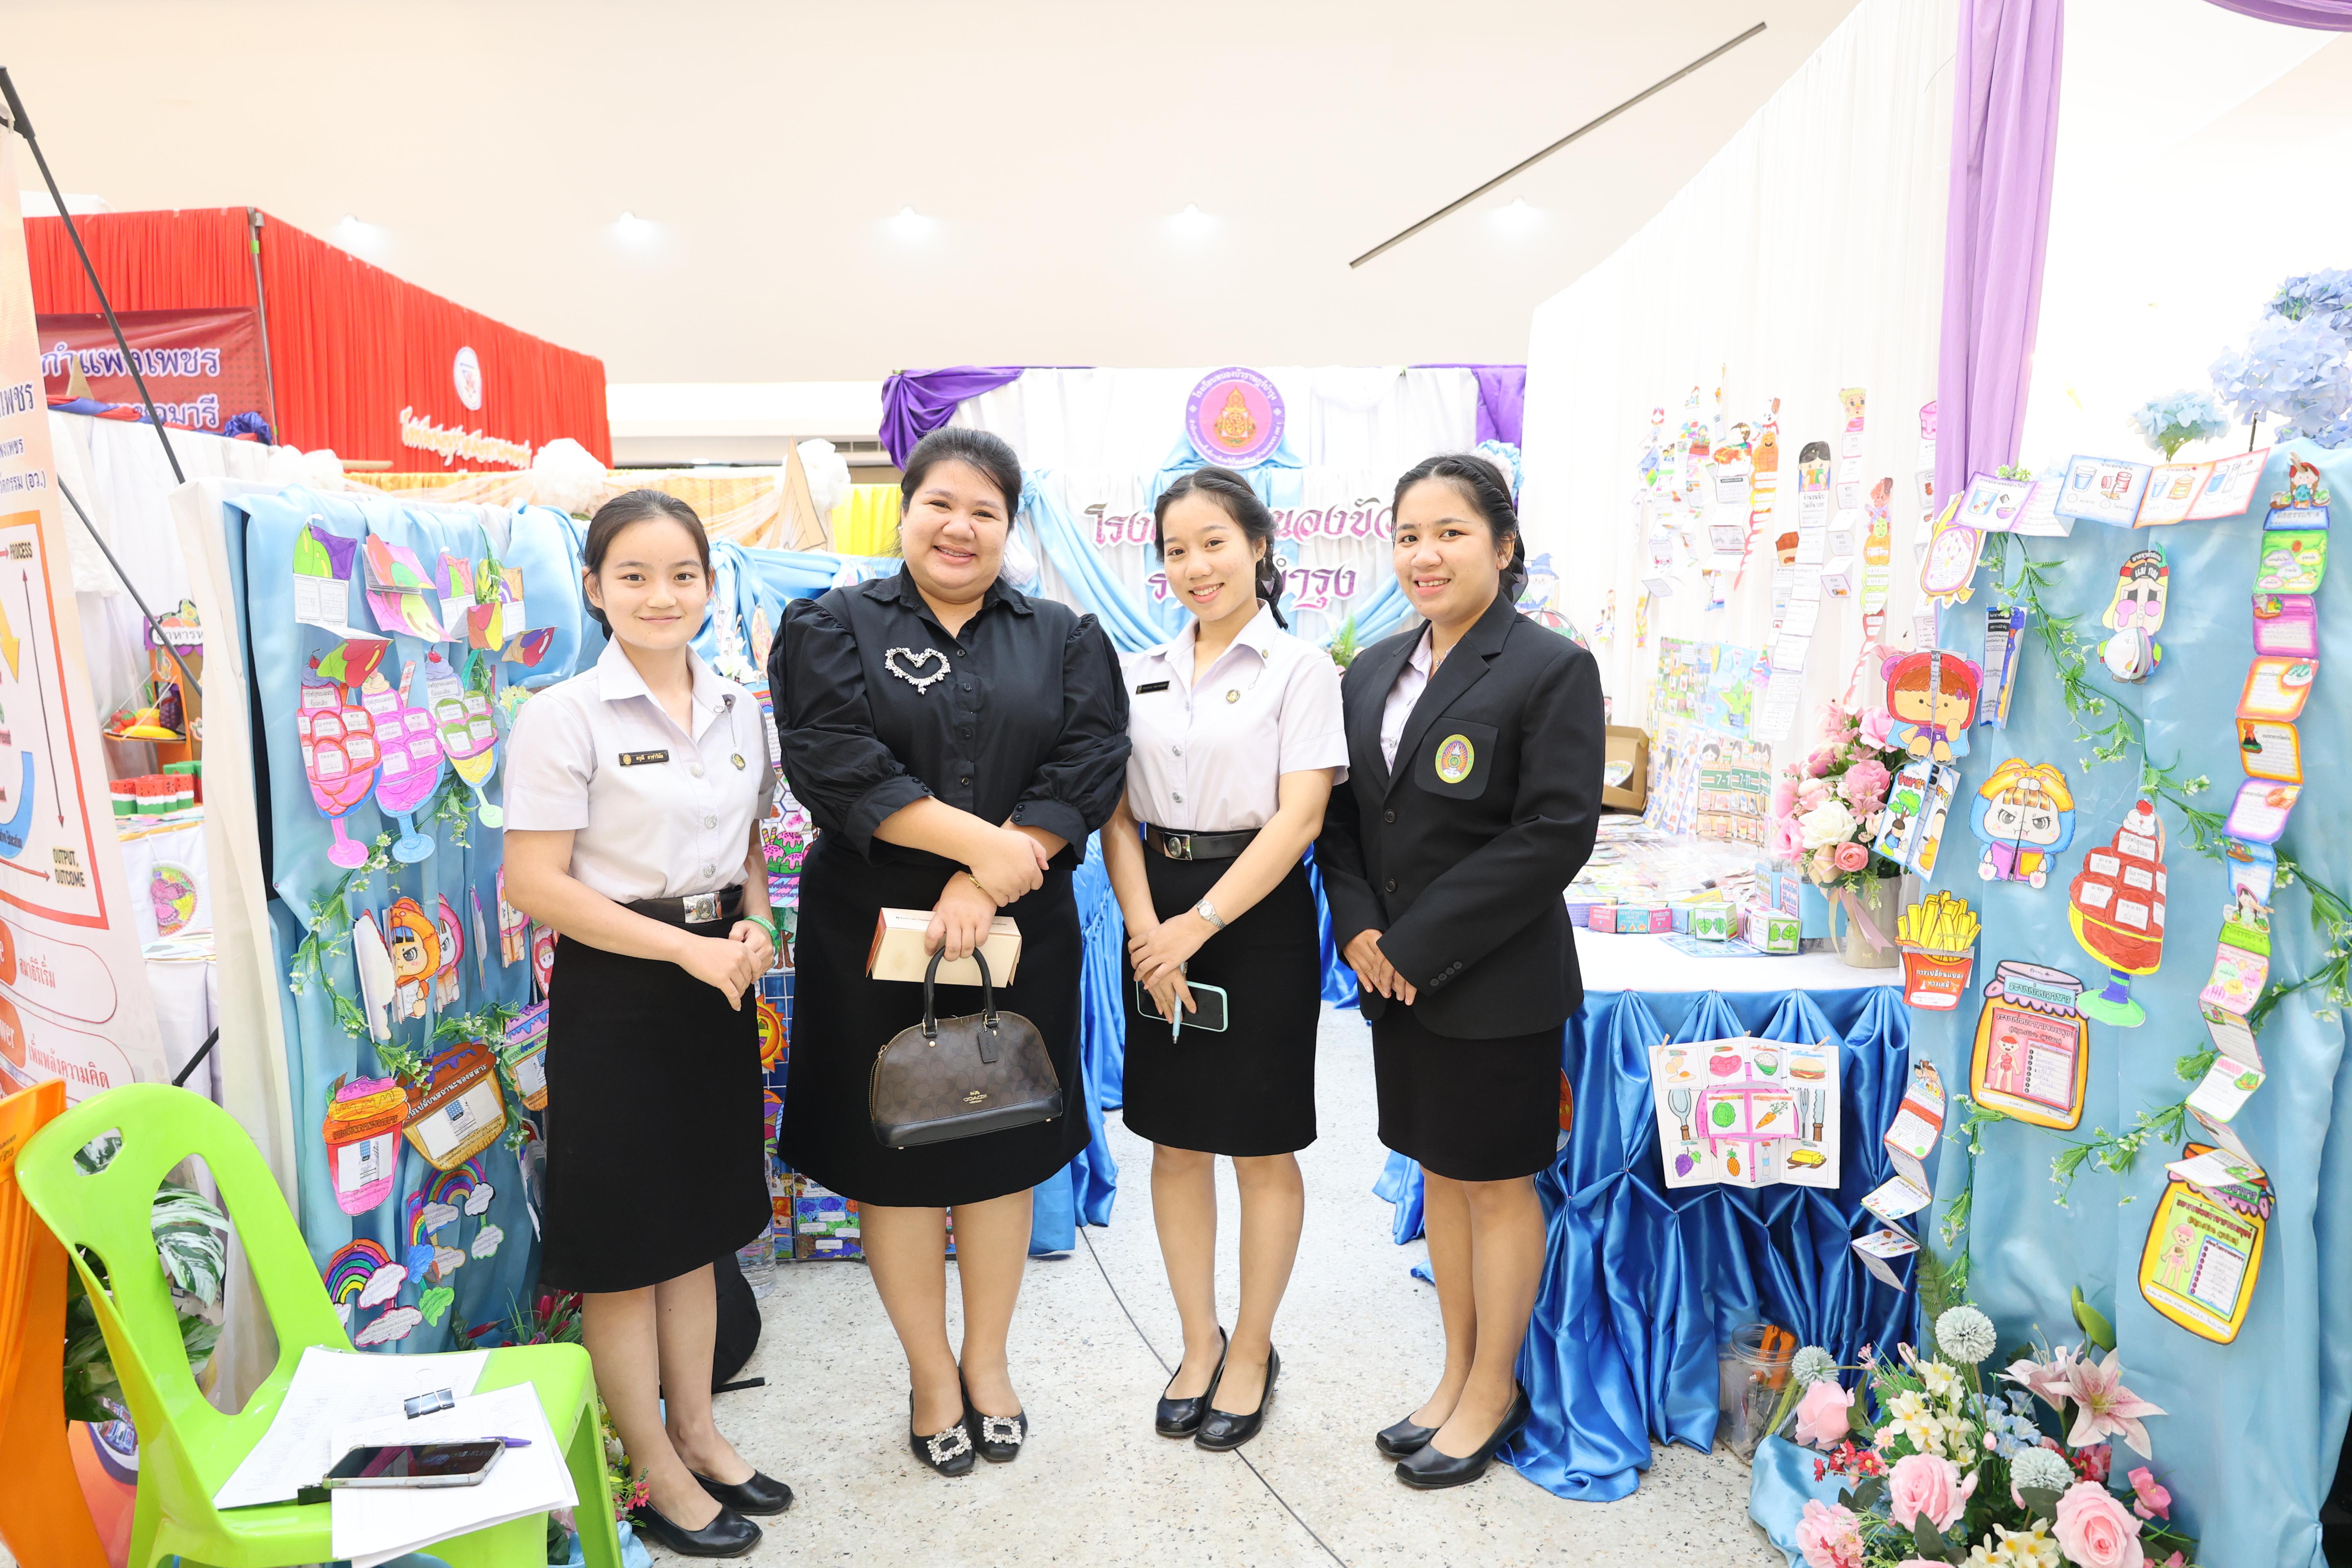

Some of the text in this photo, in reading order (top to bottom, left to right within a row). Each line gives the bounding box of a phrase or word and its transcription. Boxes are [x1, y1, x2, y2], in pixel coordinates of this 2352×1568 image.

[2101, 459, 2133, 470] น้ำและน้ำมัน
[26, 470, 46, 490] (อว.)
[1980, 477, 2028, 489] การละลายของสารในน้ำ
[2113, 503, 2134, 512] ไม่ละลาย
[10, 542, 33, 559] PROCESS
[2134, 562, 2159, 579] แม่ กม
[1739, 773, 1751, 786] 7-11
[53, 848, 78, 867] OUTPUT,
[55, 868, 85, 887] OUTCOME
[1916, 968, 1964, 979] การเปลี่ยนแปลง
[2009, 982, 2072, 1004] ระบบย่อยอาหาร
[1996, 1013, 2074, 1038] ระบบย่อยอาหารของมนุษย์
[2009, 1025, 2038, 1038] (Digestive
[28, 1033, 110, 1089] เพิ่มพลังความคิด
[406, 1063, 487, 1120] ารเปลี่ยนสถานะของสสาร
